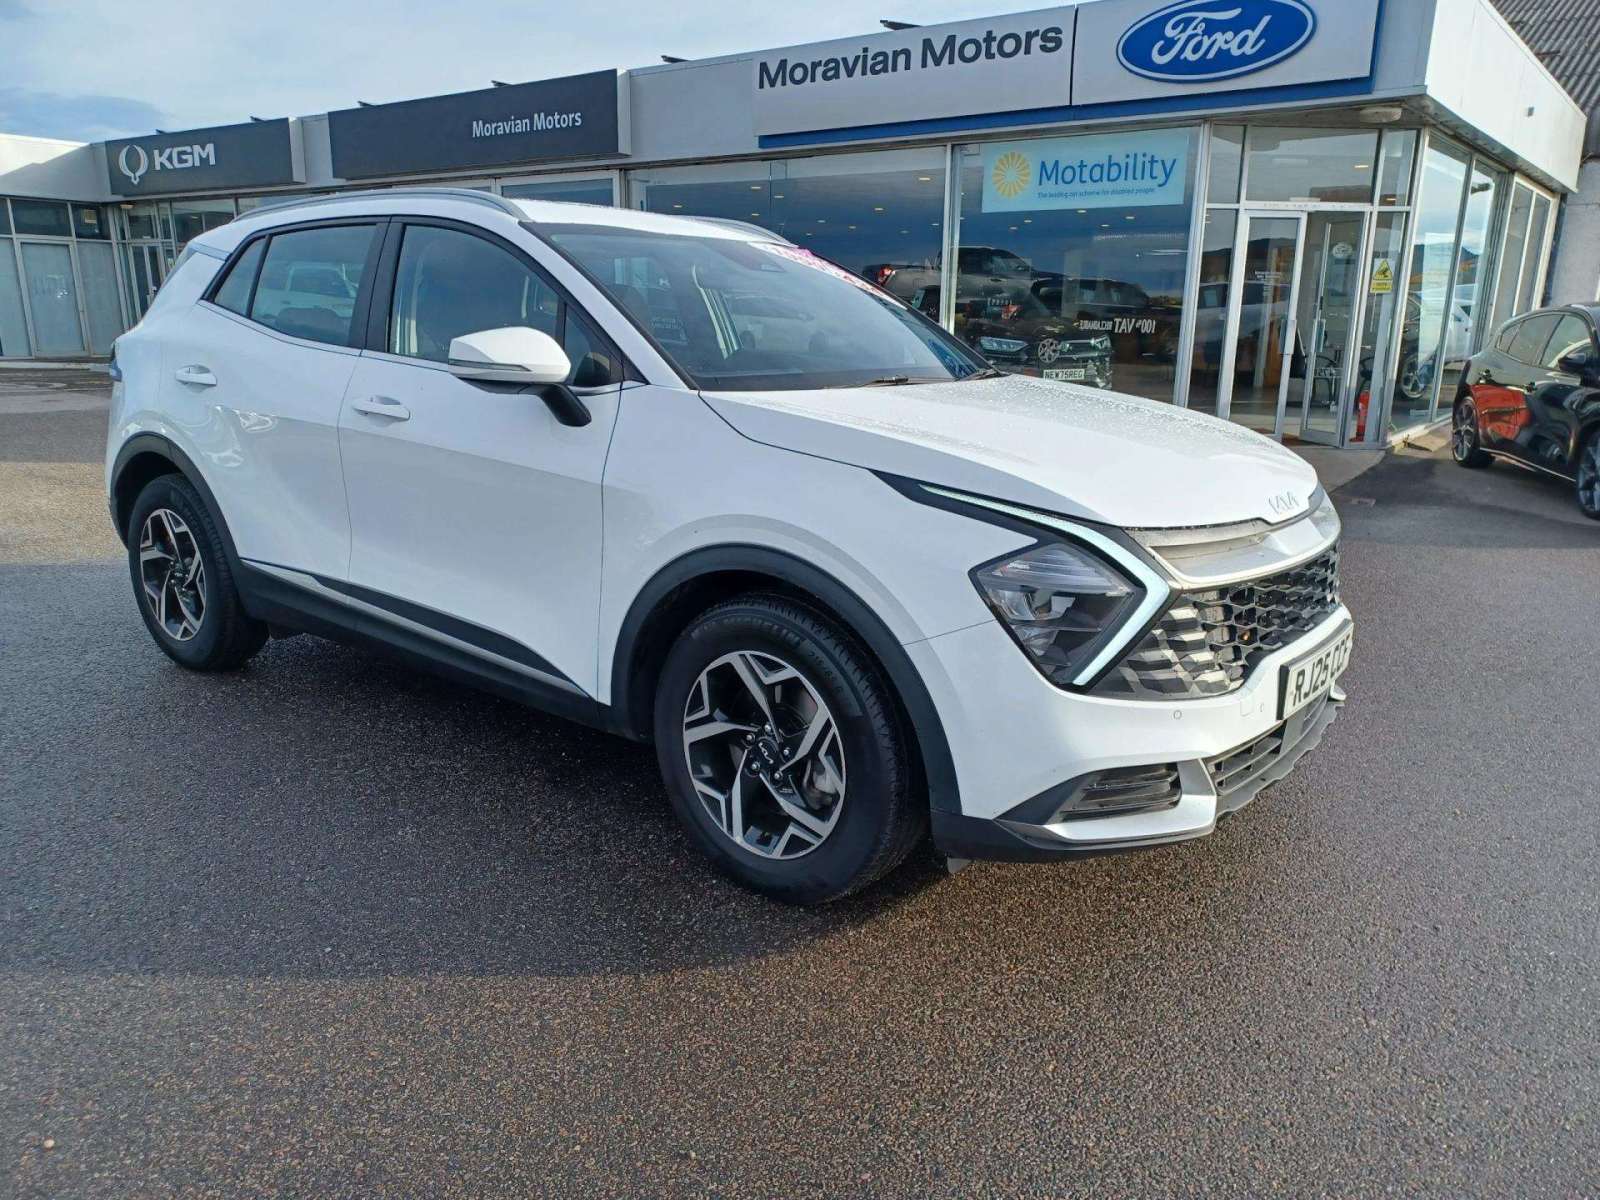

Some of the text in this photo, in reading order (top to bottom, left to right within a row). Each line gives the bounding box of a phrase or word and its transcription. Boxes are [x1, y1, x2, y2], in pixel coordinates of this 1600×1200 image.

[1151, 7, 1273, 65] Ford
[758, 26, 1064, 89] Moravian Motors
[472, 111, 582, 138] Moravian Motors
[153, 143, 216, 171] KGM
[1038, 152, 1177, 188] Motability
